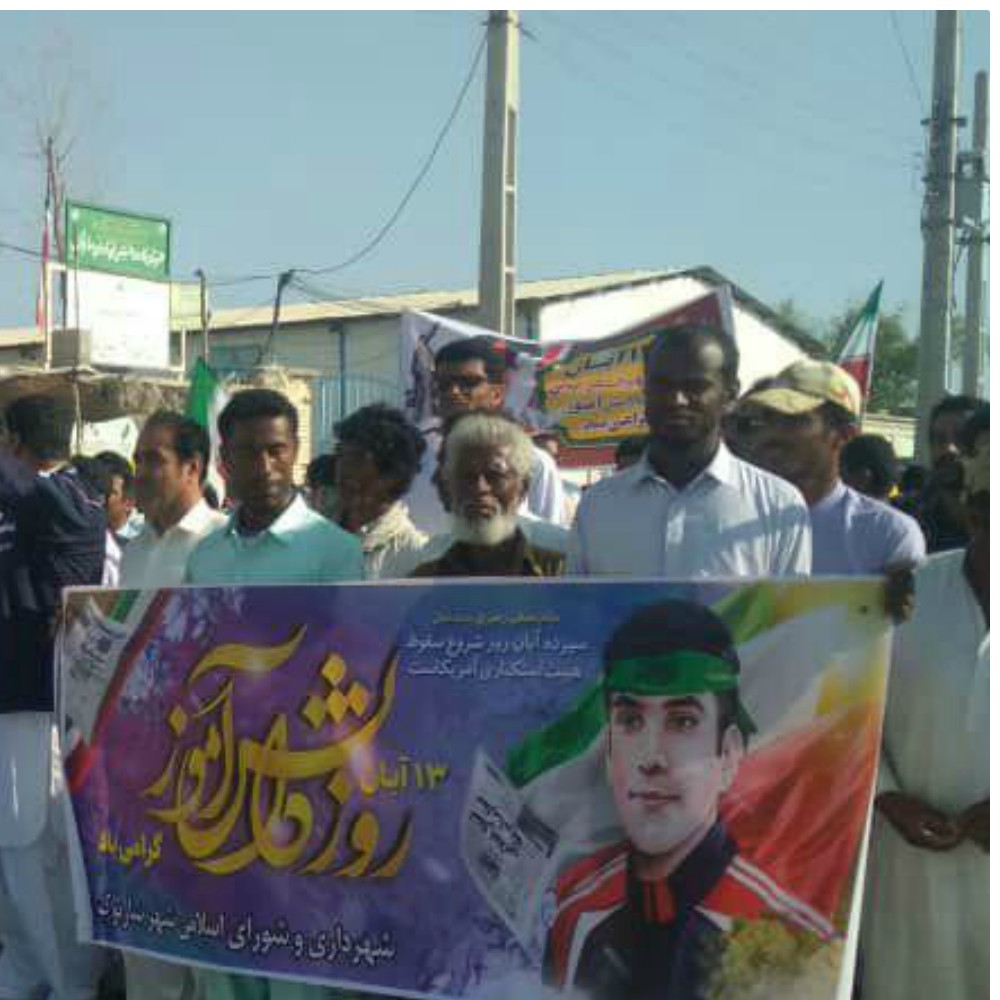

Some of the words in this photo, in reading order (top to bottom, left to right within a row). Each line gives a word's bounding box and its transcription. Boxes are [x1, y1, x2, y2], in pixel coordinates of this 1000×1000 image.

[415, 763, 450, 792] ۱۳
[118, 829, 164, 868] گرامی
[227, 914, 290, 952] شورای
[294, 931, 304, 957] و
[307, 921, 396, 965] شهرداری
